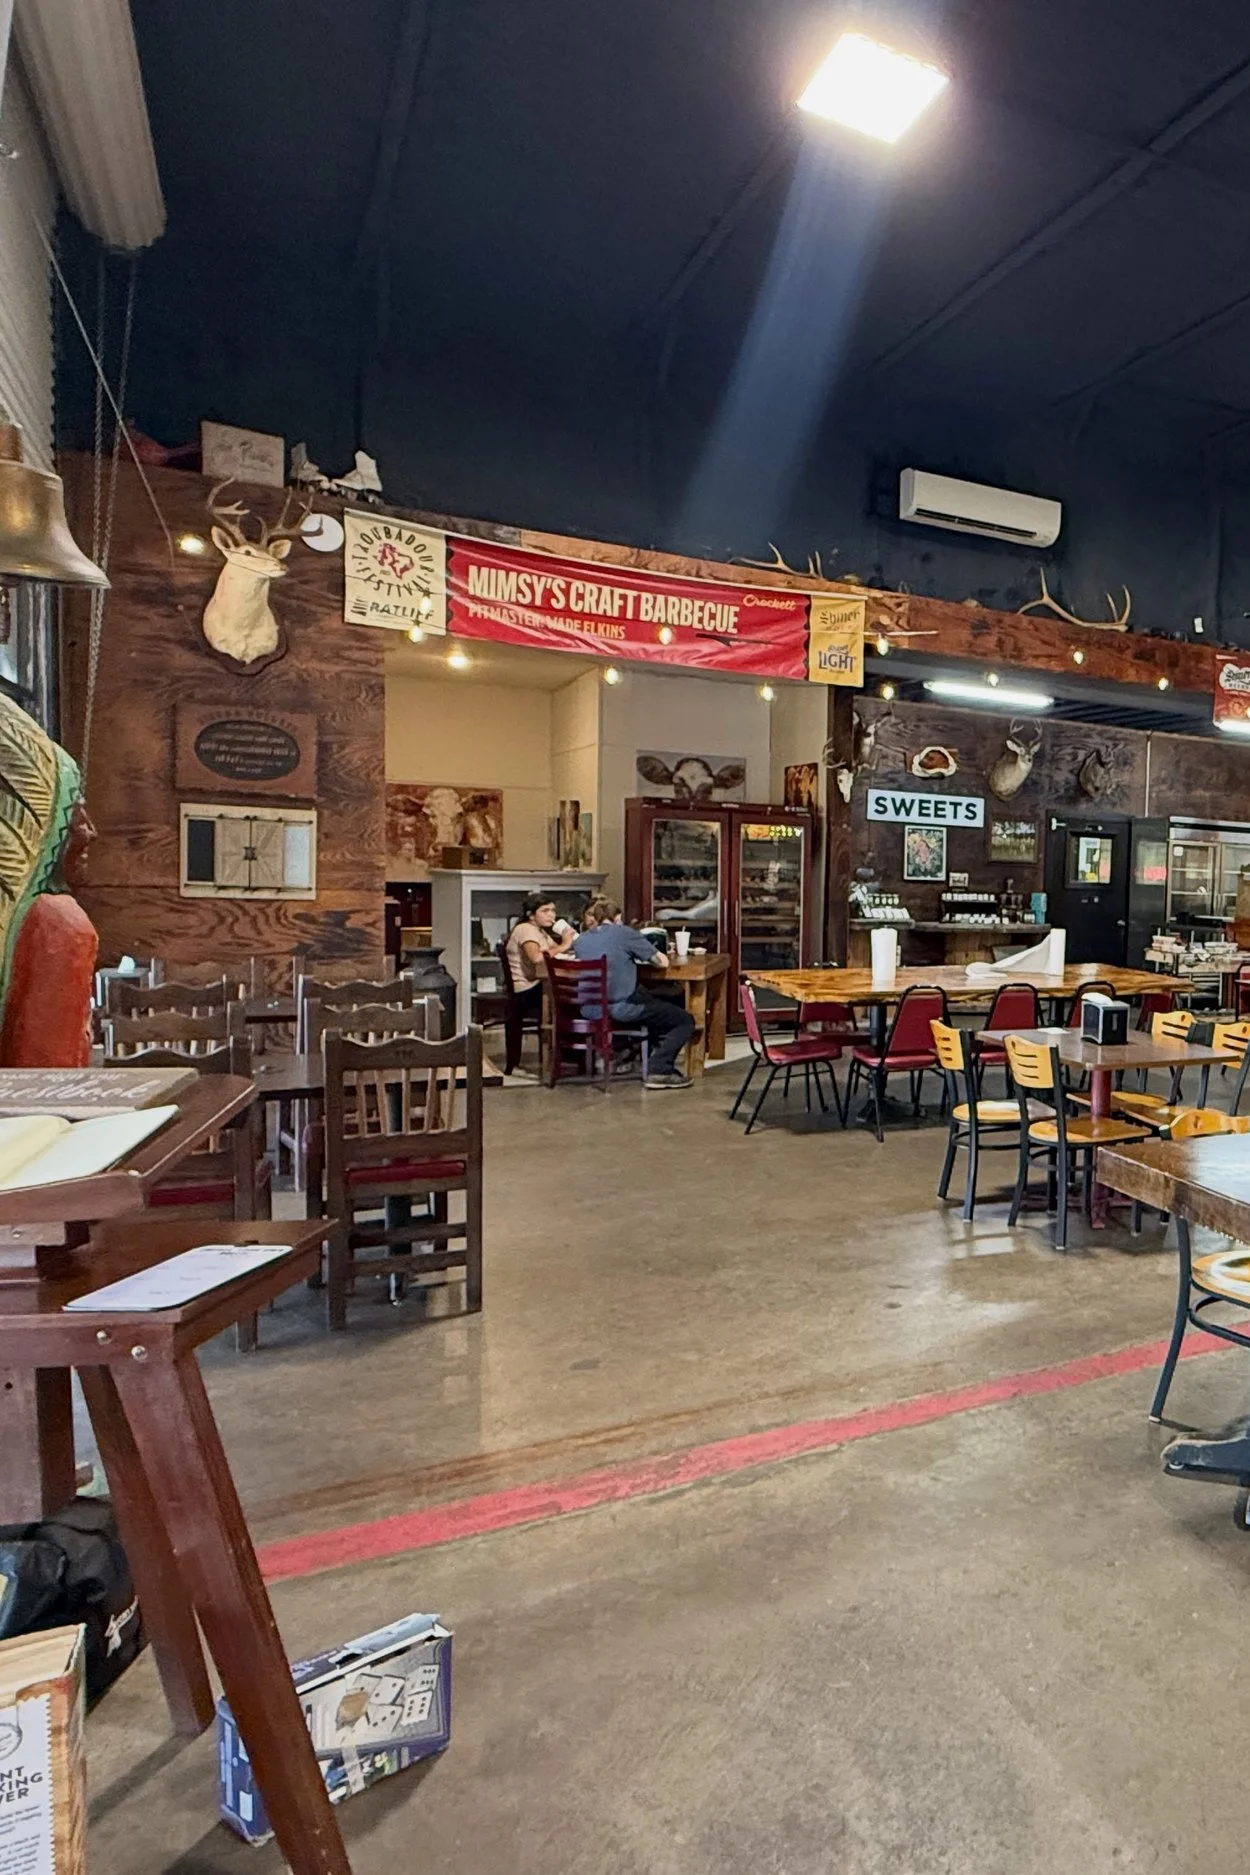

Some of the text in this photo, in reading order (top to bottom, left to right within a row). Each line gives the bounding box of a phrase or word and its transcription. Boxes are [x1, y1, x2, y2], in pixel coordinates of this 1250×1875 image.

[468, 564, 740, 635] MIMSY'S CRAFT BARBECUE
[743, 594, 797, 611] Crockett
[546, 615, 584, 633] WADE
[583, 622, 626, 641] ELKINS
[819, 651, 856, 673] LIGHT
[874, 796, 977, 820] SWEETS
